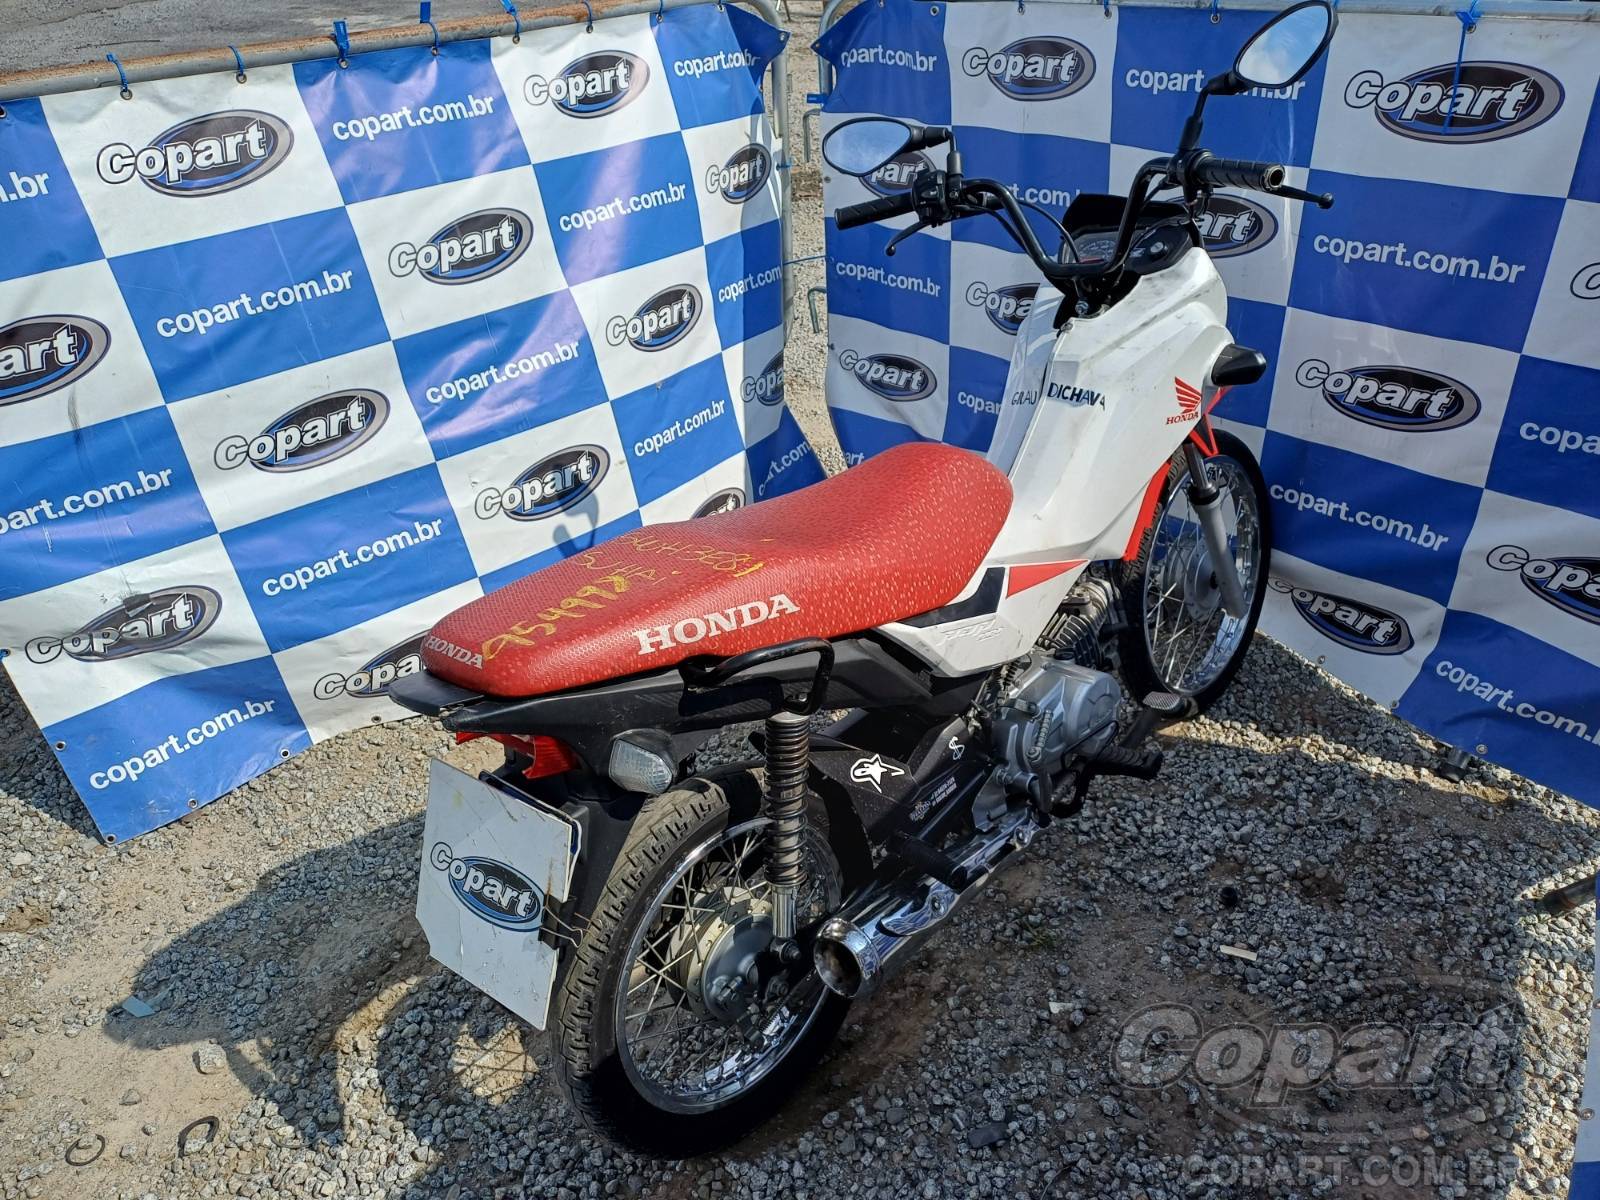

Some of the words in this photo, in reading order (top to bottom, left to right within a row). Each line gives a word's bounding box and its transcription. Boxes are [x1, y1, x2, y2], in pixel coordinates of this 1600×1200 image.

[524, 57, 630, 105] Copart
[673, 47, 761, 79] copart.cobr
[962, 47, 1079, 89] Copart
[332, 95, 494, 142] copart.com.br
[1344, 69, 1536, 123] Copart
[97, 119, 270, 185] Copart
[706, 151, 765, 195] Copart
[558, 181, 686, 233] copart.com.br
[388, 216, 516, 278] Copart
[1313, 234, 1526, 284] copart.com.br
[156, 269, 354, 338] copart.com.br
[718, 263, 783, 303] copart.com
[836, 261, 941, 297] copart.com.br
[966, 281, 1036, 320] Copa
[606, 293, 692, 347] Copart
[425, 339, 581, 404] copart.com.br
[740, 364, 785, 402] Copa
[839, 349, 924, 394] Copart
[1296, 358, 1456, 421] Copart
[214, 395, 368, 470] Copart
[634, 399, 726, 457] copart.com.br
[1166, 411, 1200, 426] HONDA
[475, 448, 594, 520] Copart
[1269, 484, 1449, 551] copart.com.br
[262, 517, 443, 597] copart.com.br
[25, 593, 194, 664] Copart
[634, 593, 800, 655] HONDA
[1268, 576, 1399, 645] Copart
[313, 653, 425, 700] Copa
[425, 635, 484, 669] HONDA
[89, 699, 275, 789] copart.com.br
[430, 841, 535, 918] Copart
